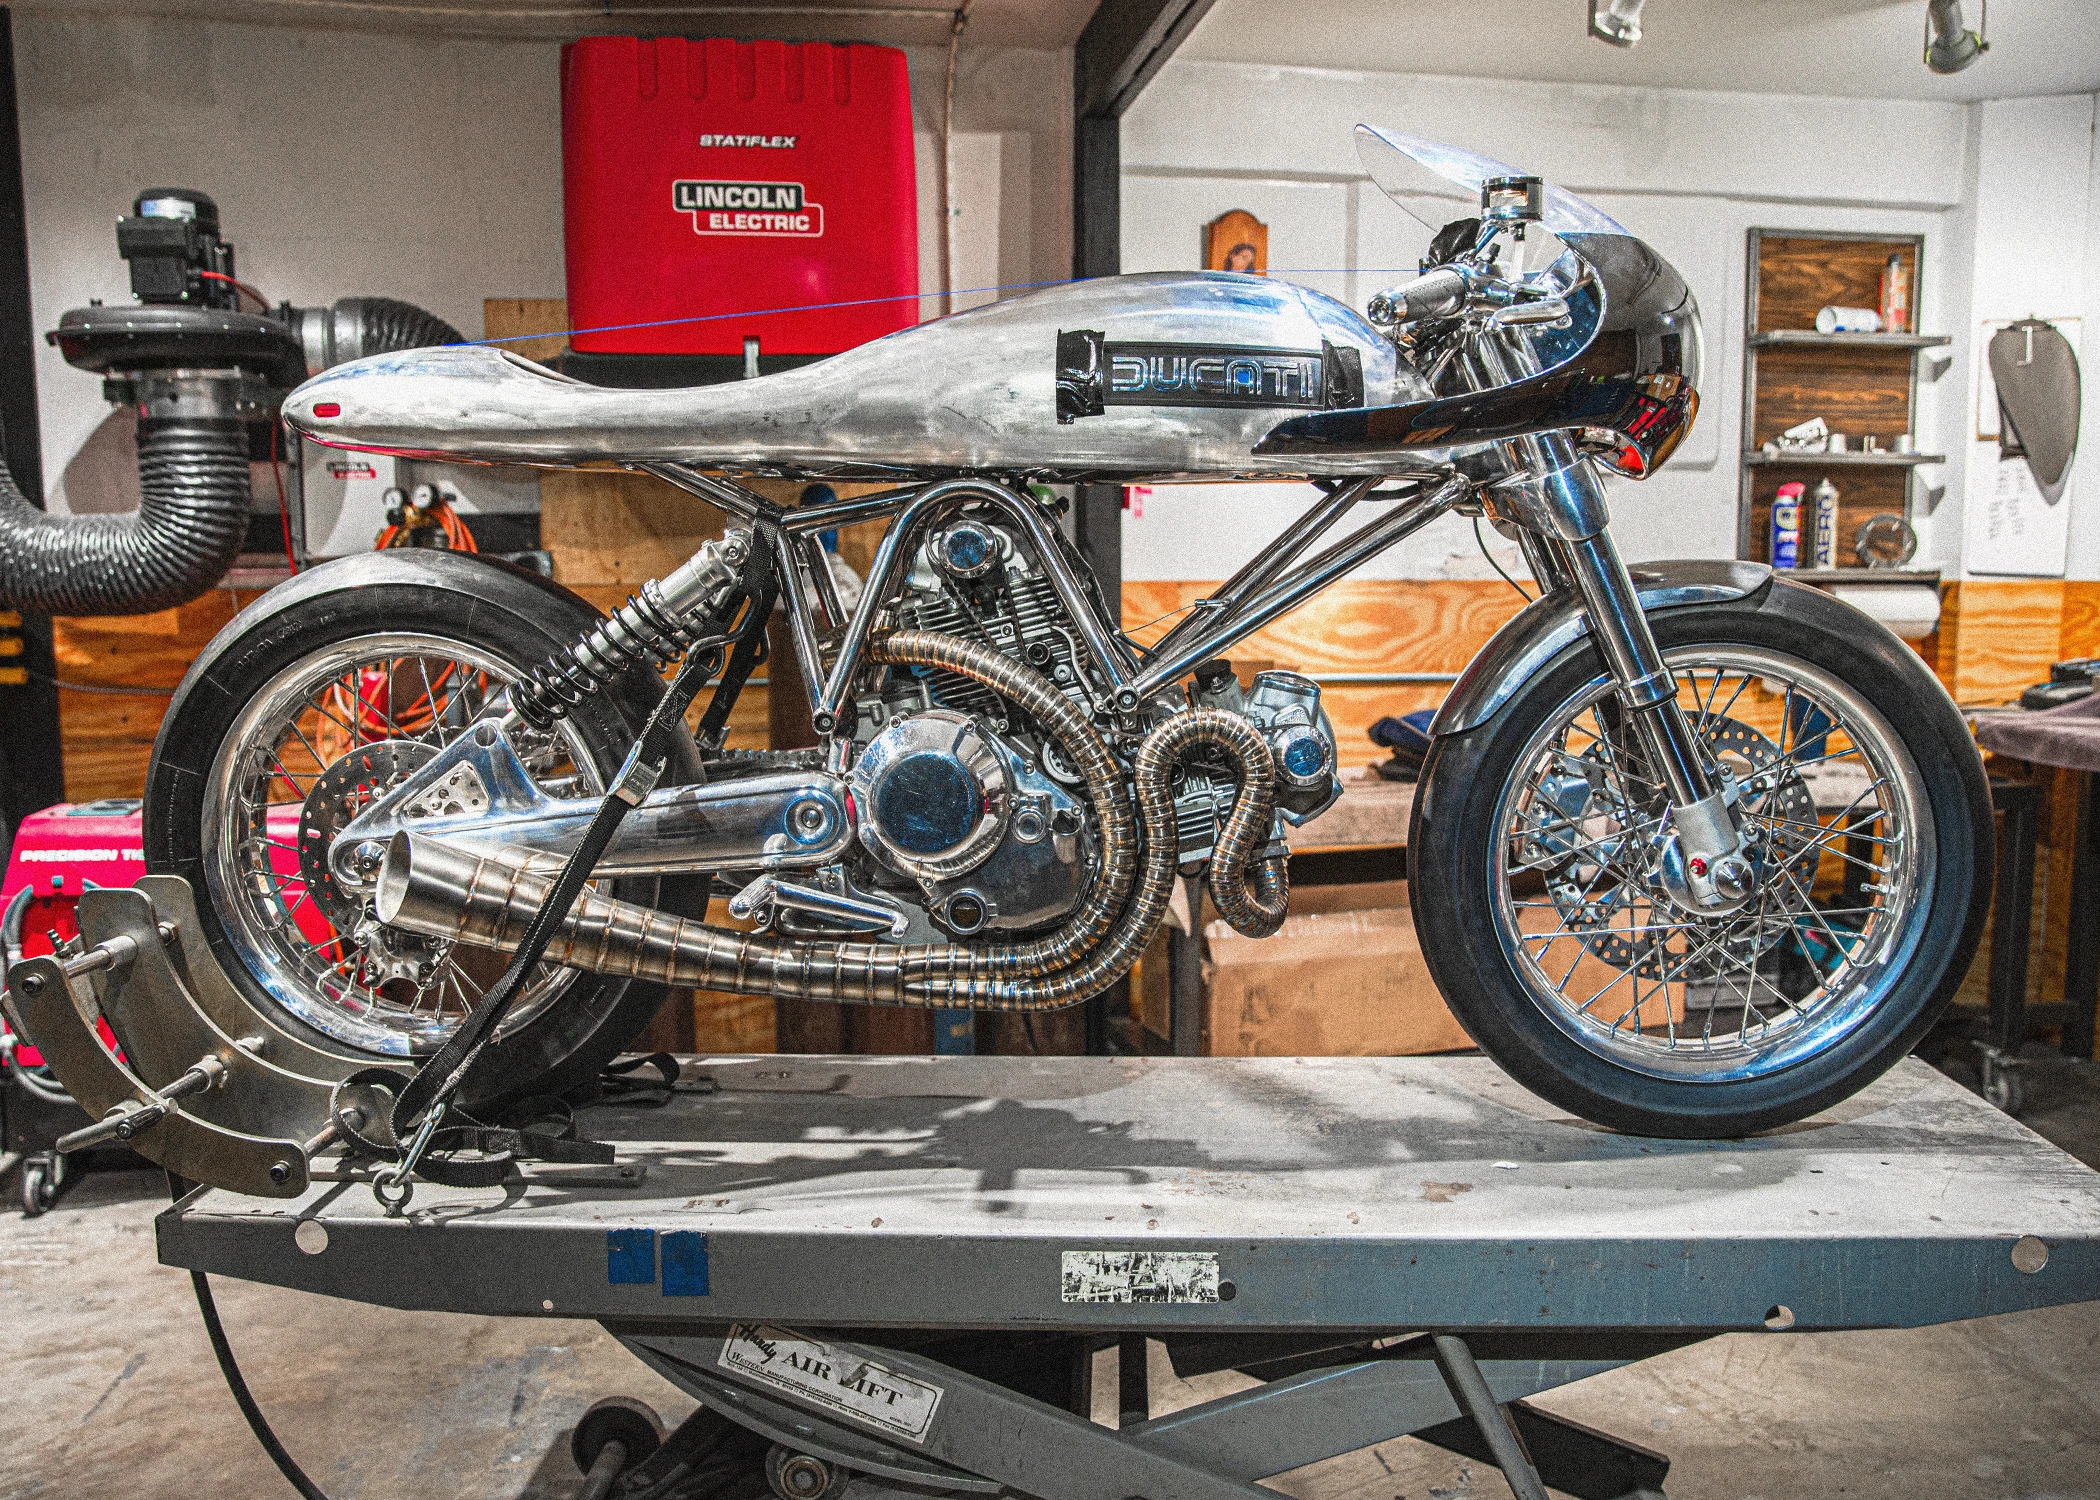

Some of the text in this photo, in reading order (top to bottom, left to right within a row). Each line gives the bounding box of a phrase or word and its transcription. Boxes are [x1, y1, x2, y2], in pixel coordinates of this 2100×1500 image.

[699, 134, 797, 148] STATIFLEX
[681, 185, 797, 209] LINCOLN
[709, 213, 810, 231] ELECTRIC
[1112, 356, 1314, 398] DUCATI
[1817, 495, 1834, 565] AERO
[781, 1351, 832, 1381] AIR
